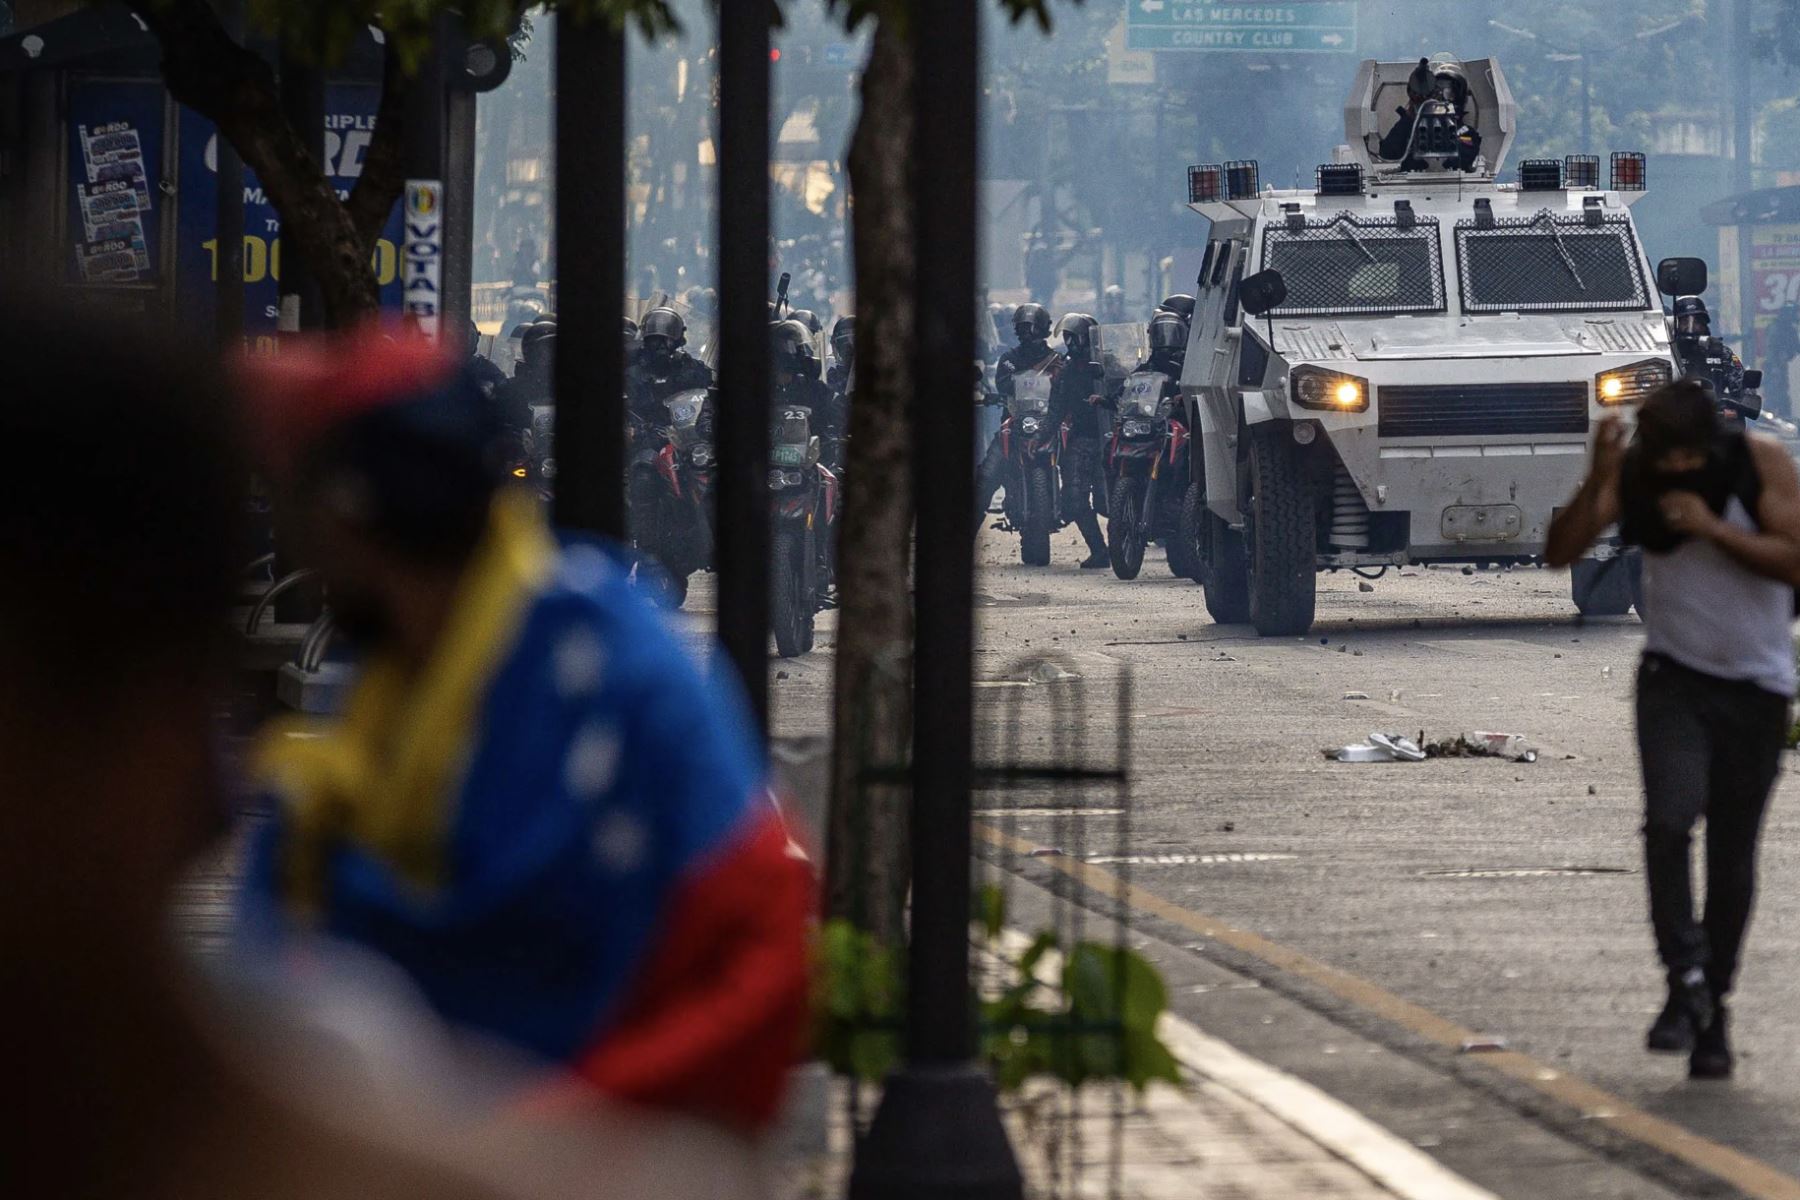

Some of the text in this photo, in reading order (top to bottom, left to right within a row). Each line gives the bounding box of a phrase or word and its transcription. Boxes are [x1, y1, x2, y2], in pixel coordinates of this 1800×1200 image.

[1171, 8, 1296, 22] LAS MERCEDES
[1173, 31, 1293, 45] COUNTRY CLUB
[784, 410, 806, 420] 23
